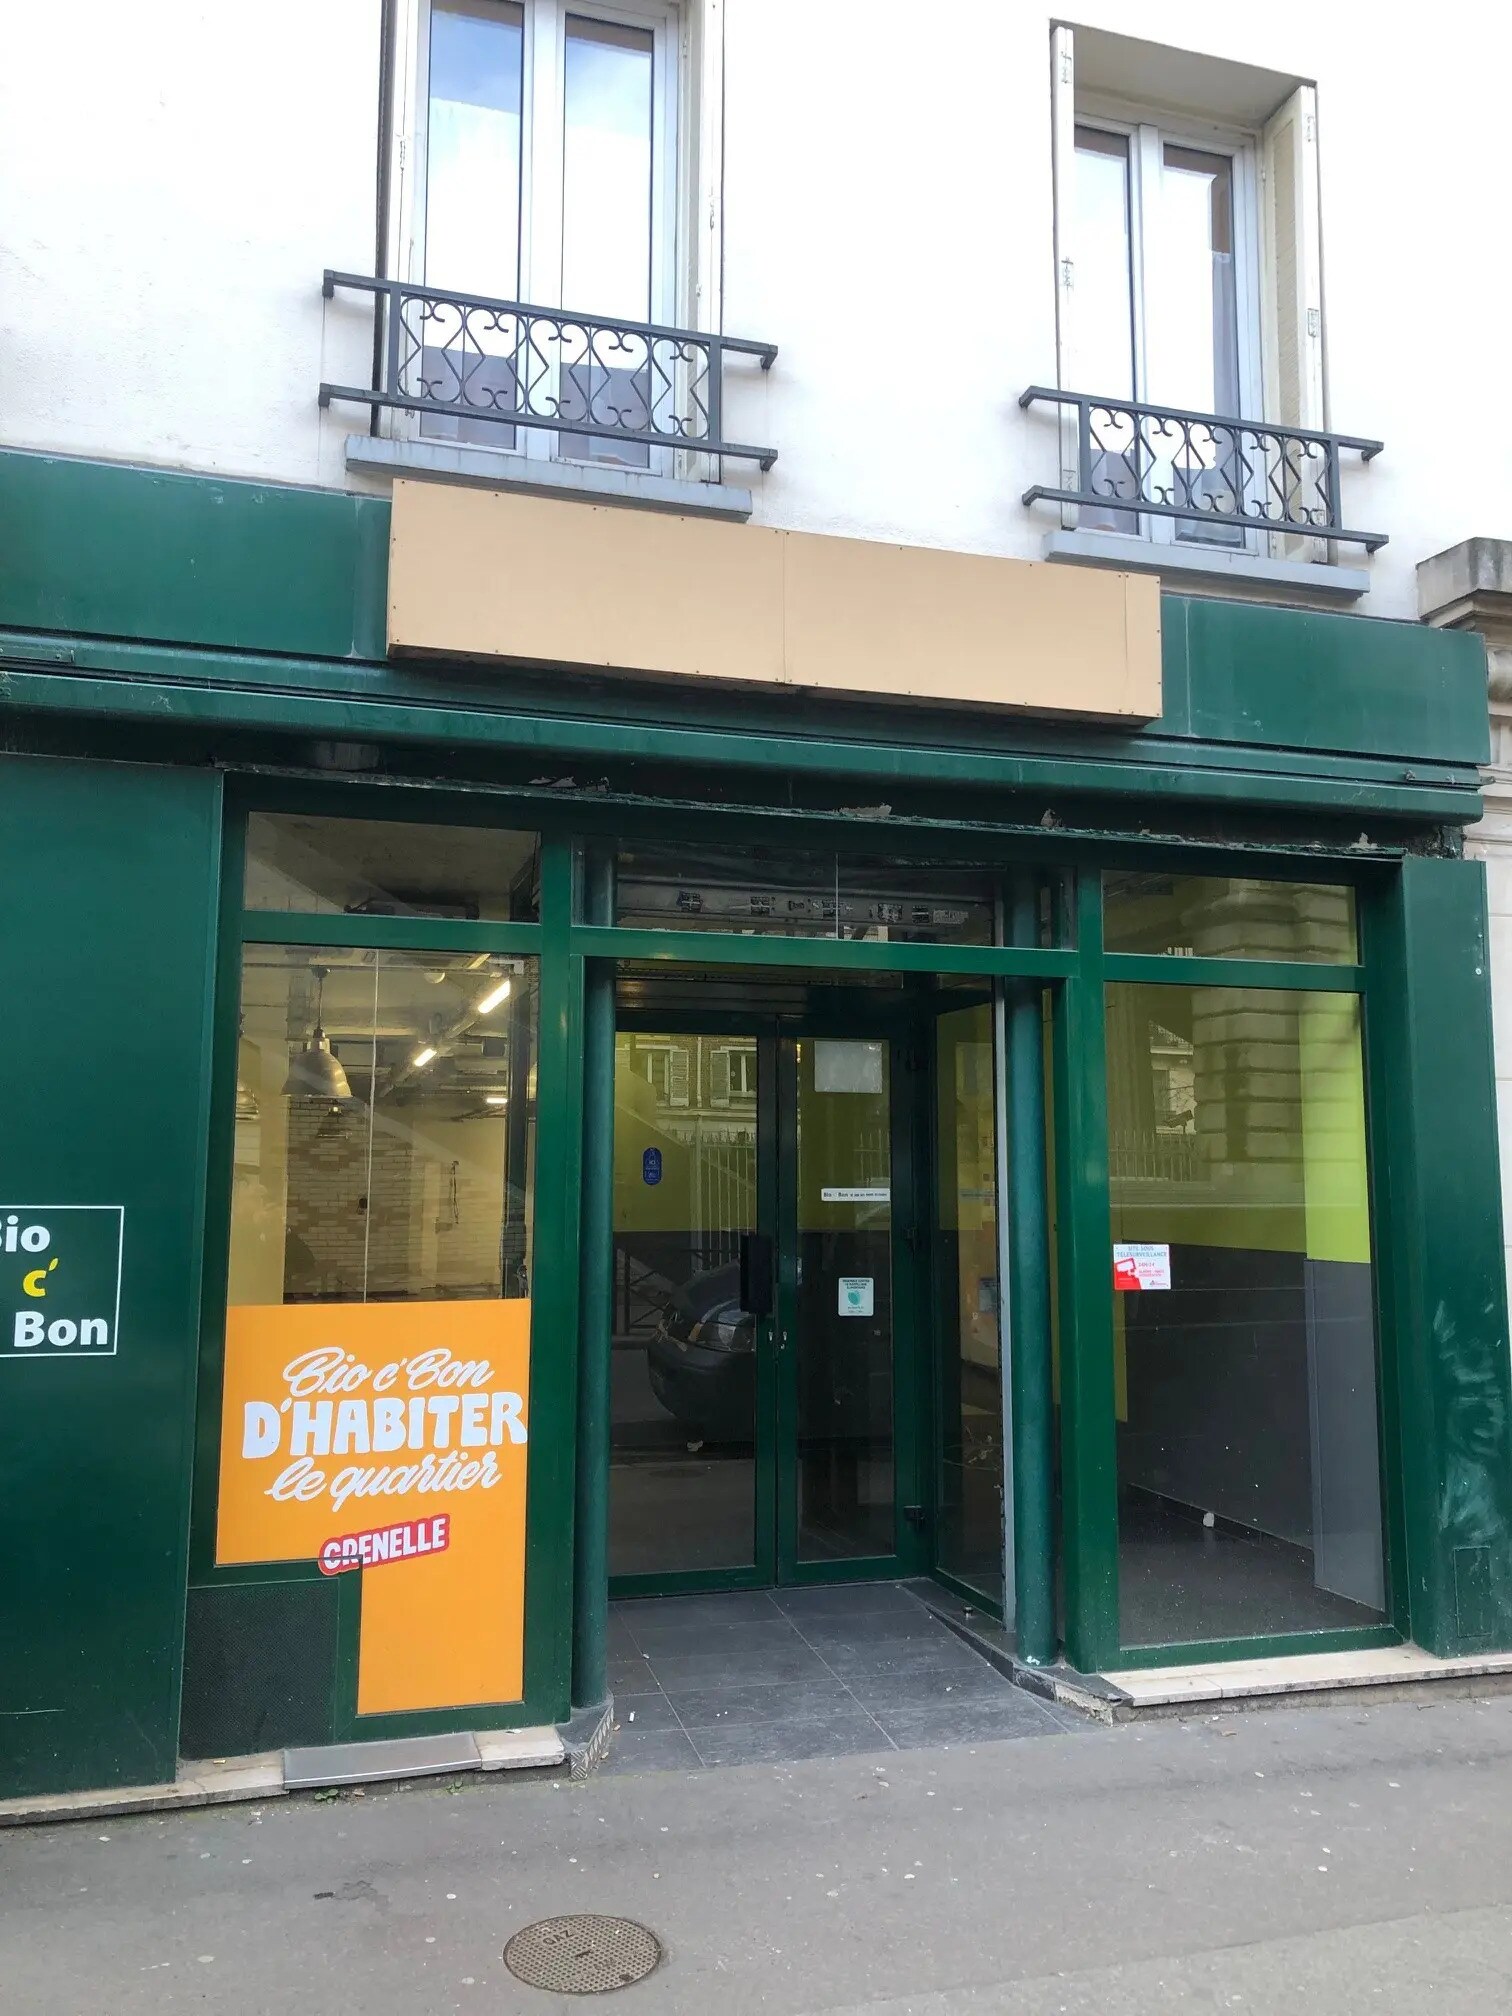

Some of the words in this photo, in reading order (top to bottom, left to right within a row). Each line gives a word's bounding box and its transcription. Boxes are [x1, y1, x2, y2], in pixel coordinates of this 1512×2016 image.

[0, 1214, 51, 1253] io
[13, 1310, 108, 1348] Bon
[282, 1346, 372, 1398] Bio
[241, 1391, 528, 1459] D'HABITER
[264, 1456, 328, 1502] le
[329, 1449, 503, 1513] quartier
[323, 1517, 447, 1570] GRENELLE
